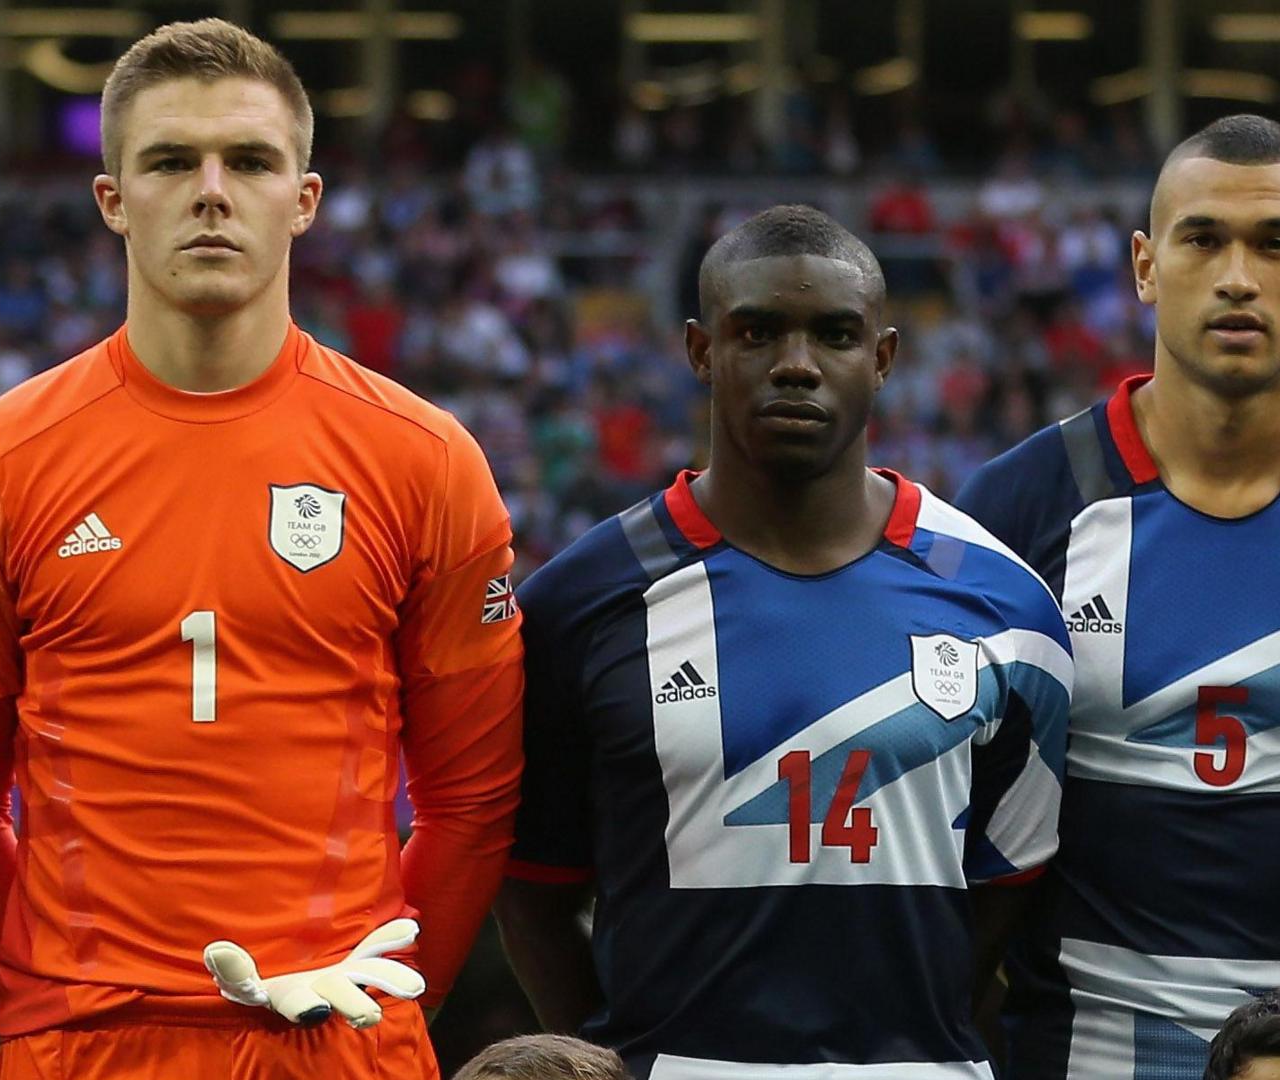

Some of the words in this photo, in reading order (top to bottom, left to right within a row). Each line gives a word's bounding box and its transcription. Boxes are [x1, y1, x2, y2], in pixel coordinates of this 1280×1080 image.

[288, 521, 311, 530] TEAM
[313, 524, 326, 532] GB
[58, 537, 121, 558] adidas
[180, 610, 217, 722] 1
[930, 670, 951, 678] TEAM
[953, 672, 964, 680] GB
[656, 685, 716, 703] adidas
[1194, 686, 1249, 787] 5
[778, 750, 877, 863] 14
